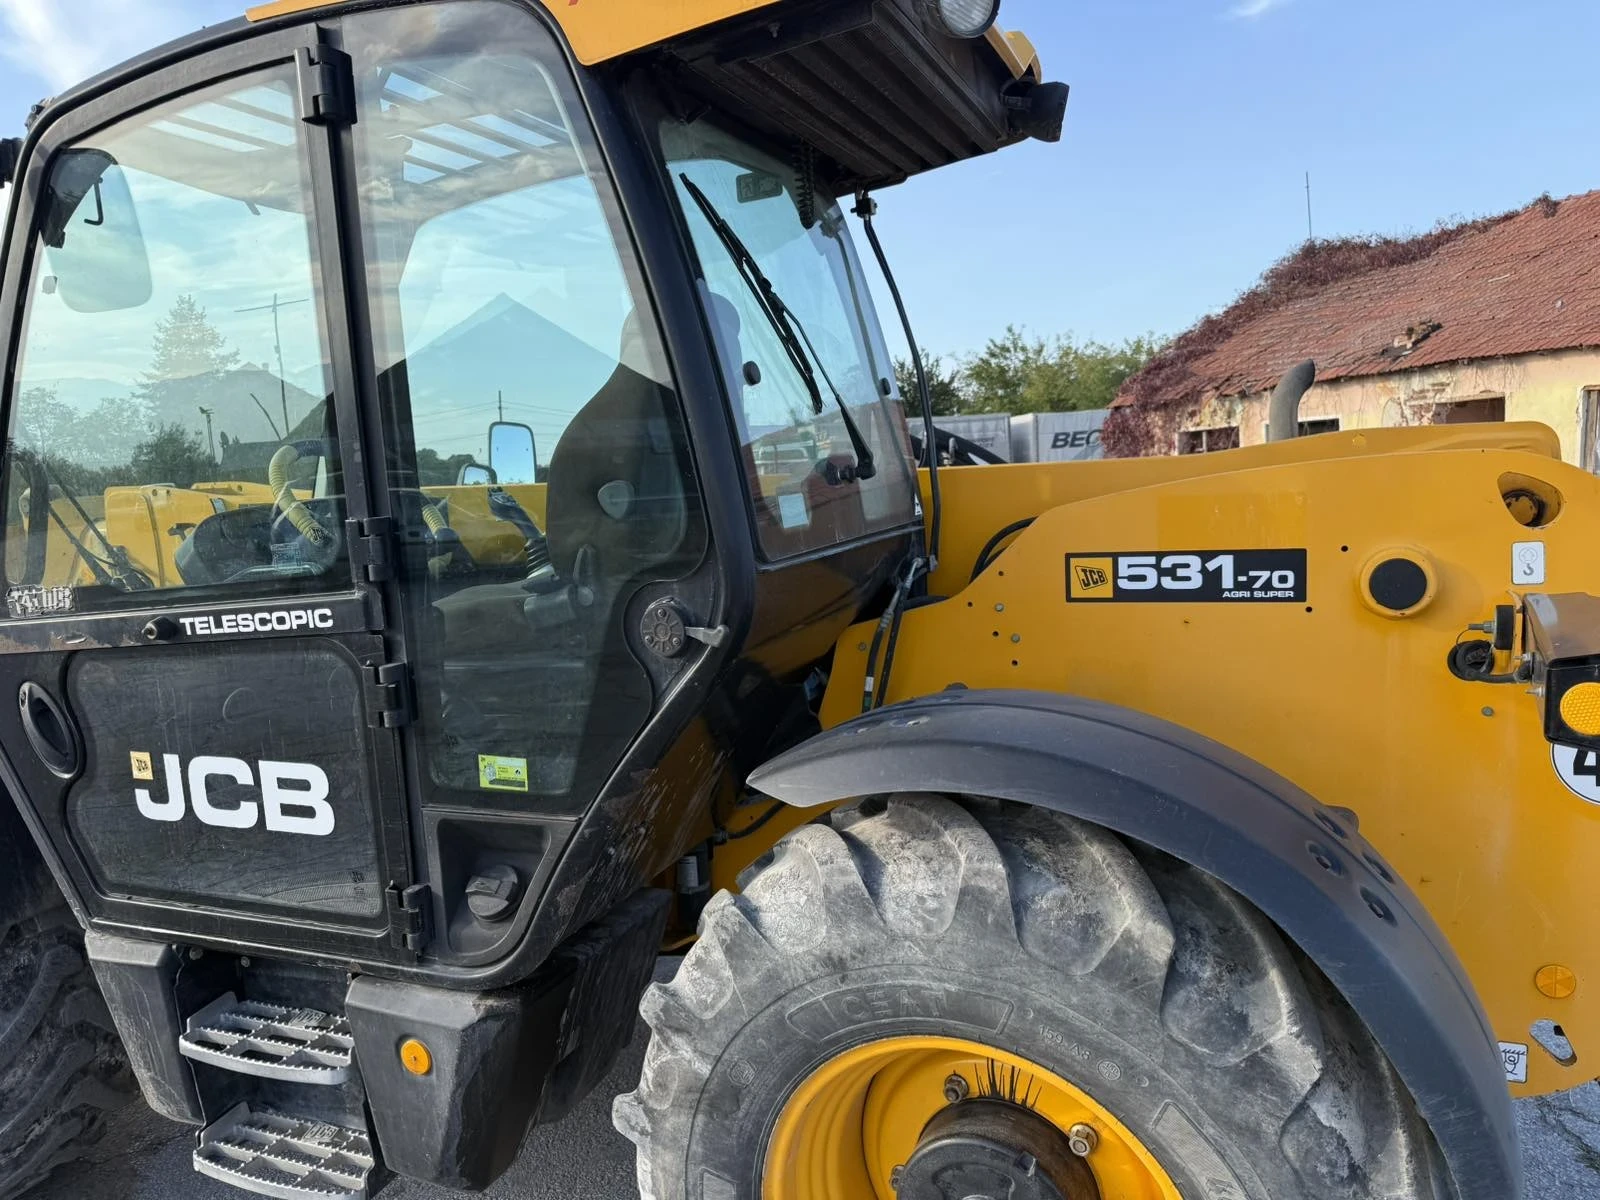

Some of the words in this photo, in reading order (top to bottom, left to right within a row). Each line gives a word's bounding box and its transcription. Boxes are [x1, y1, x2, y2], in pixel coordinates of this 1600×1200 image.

[1081, 568, 1106, 588] JCB
[1117, 554, 1295, 590] 531-70
[1253, 590, 1294, 598] SUPER
[179, 608, 333, 635] TELESCOPIC
[134, 752, 336, 837] JCB
